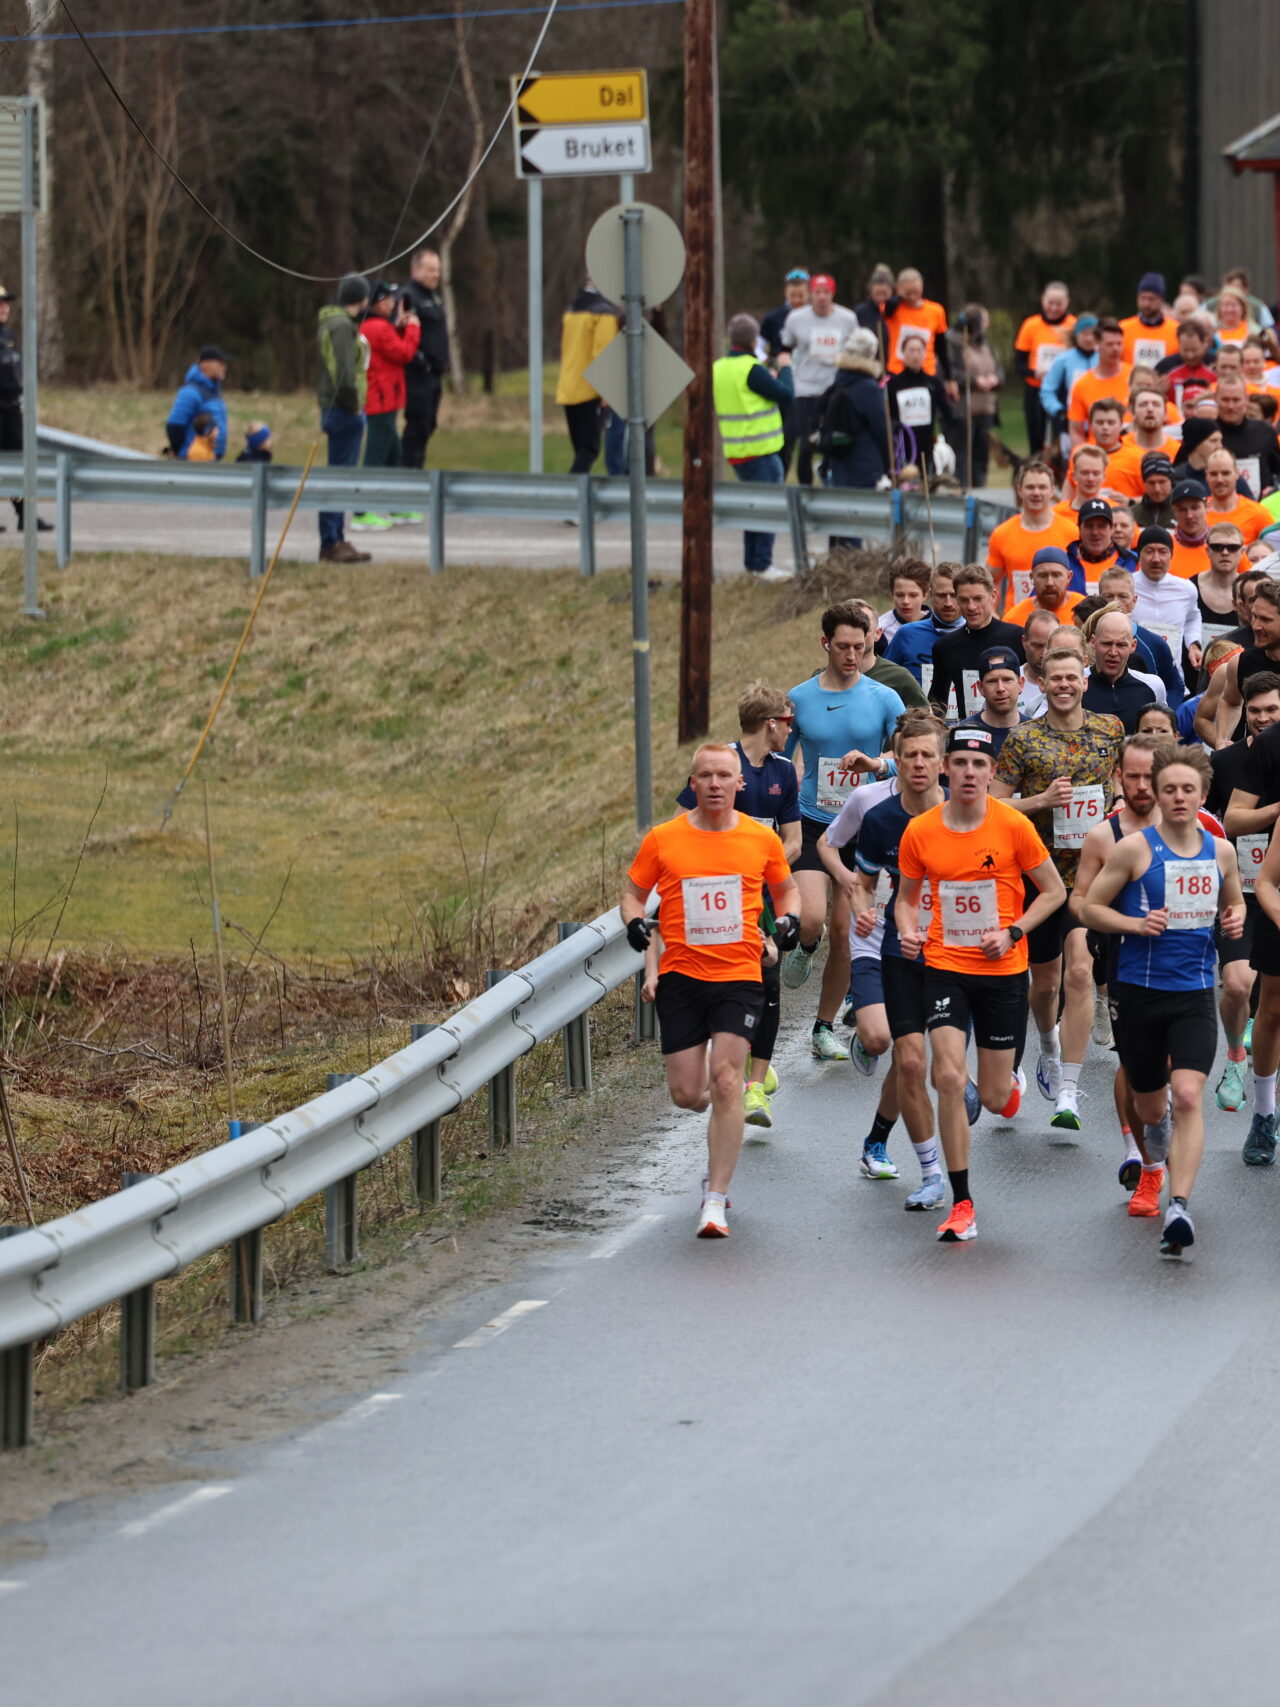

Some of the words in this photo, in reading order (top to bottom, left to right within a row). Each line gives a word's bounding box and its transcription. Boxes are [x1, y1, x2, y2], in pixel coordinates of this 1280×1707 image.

[599, 86, 634, 107] Dal
[564, 137, 636, 159] Bruket
[827, 770, 861, 787] 170
[1063, 799, 1099, 819] 175
[1175, 875, 1213, 895] 188
[701, 891, 728, 911] 16
[954, 895, 981, 914] 56
[1169, 910, 1209, 919] RETURA
[689, 925, 735, 935] RETURA
[947, 928, 990, 937] RETURA
